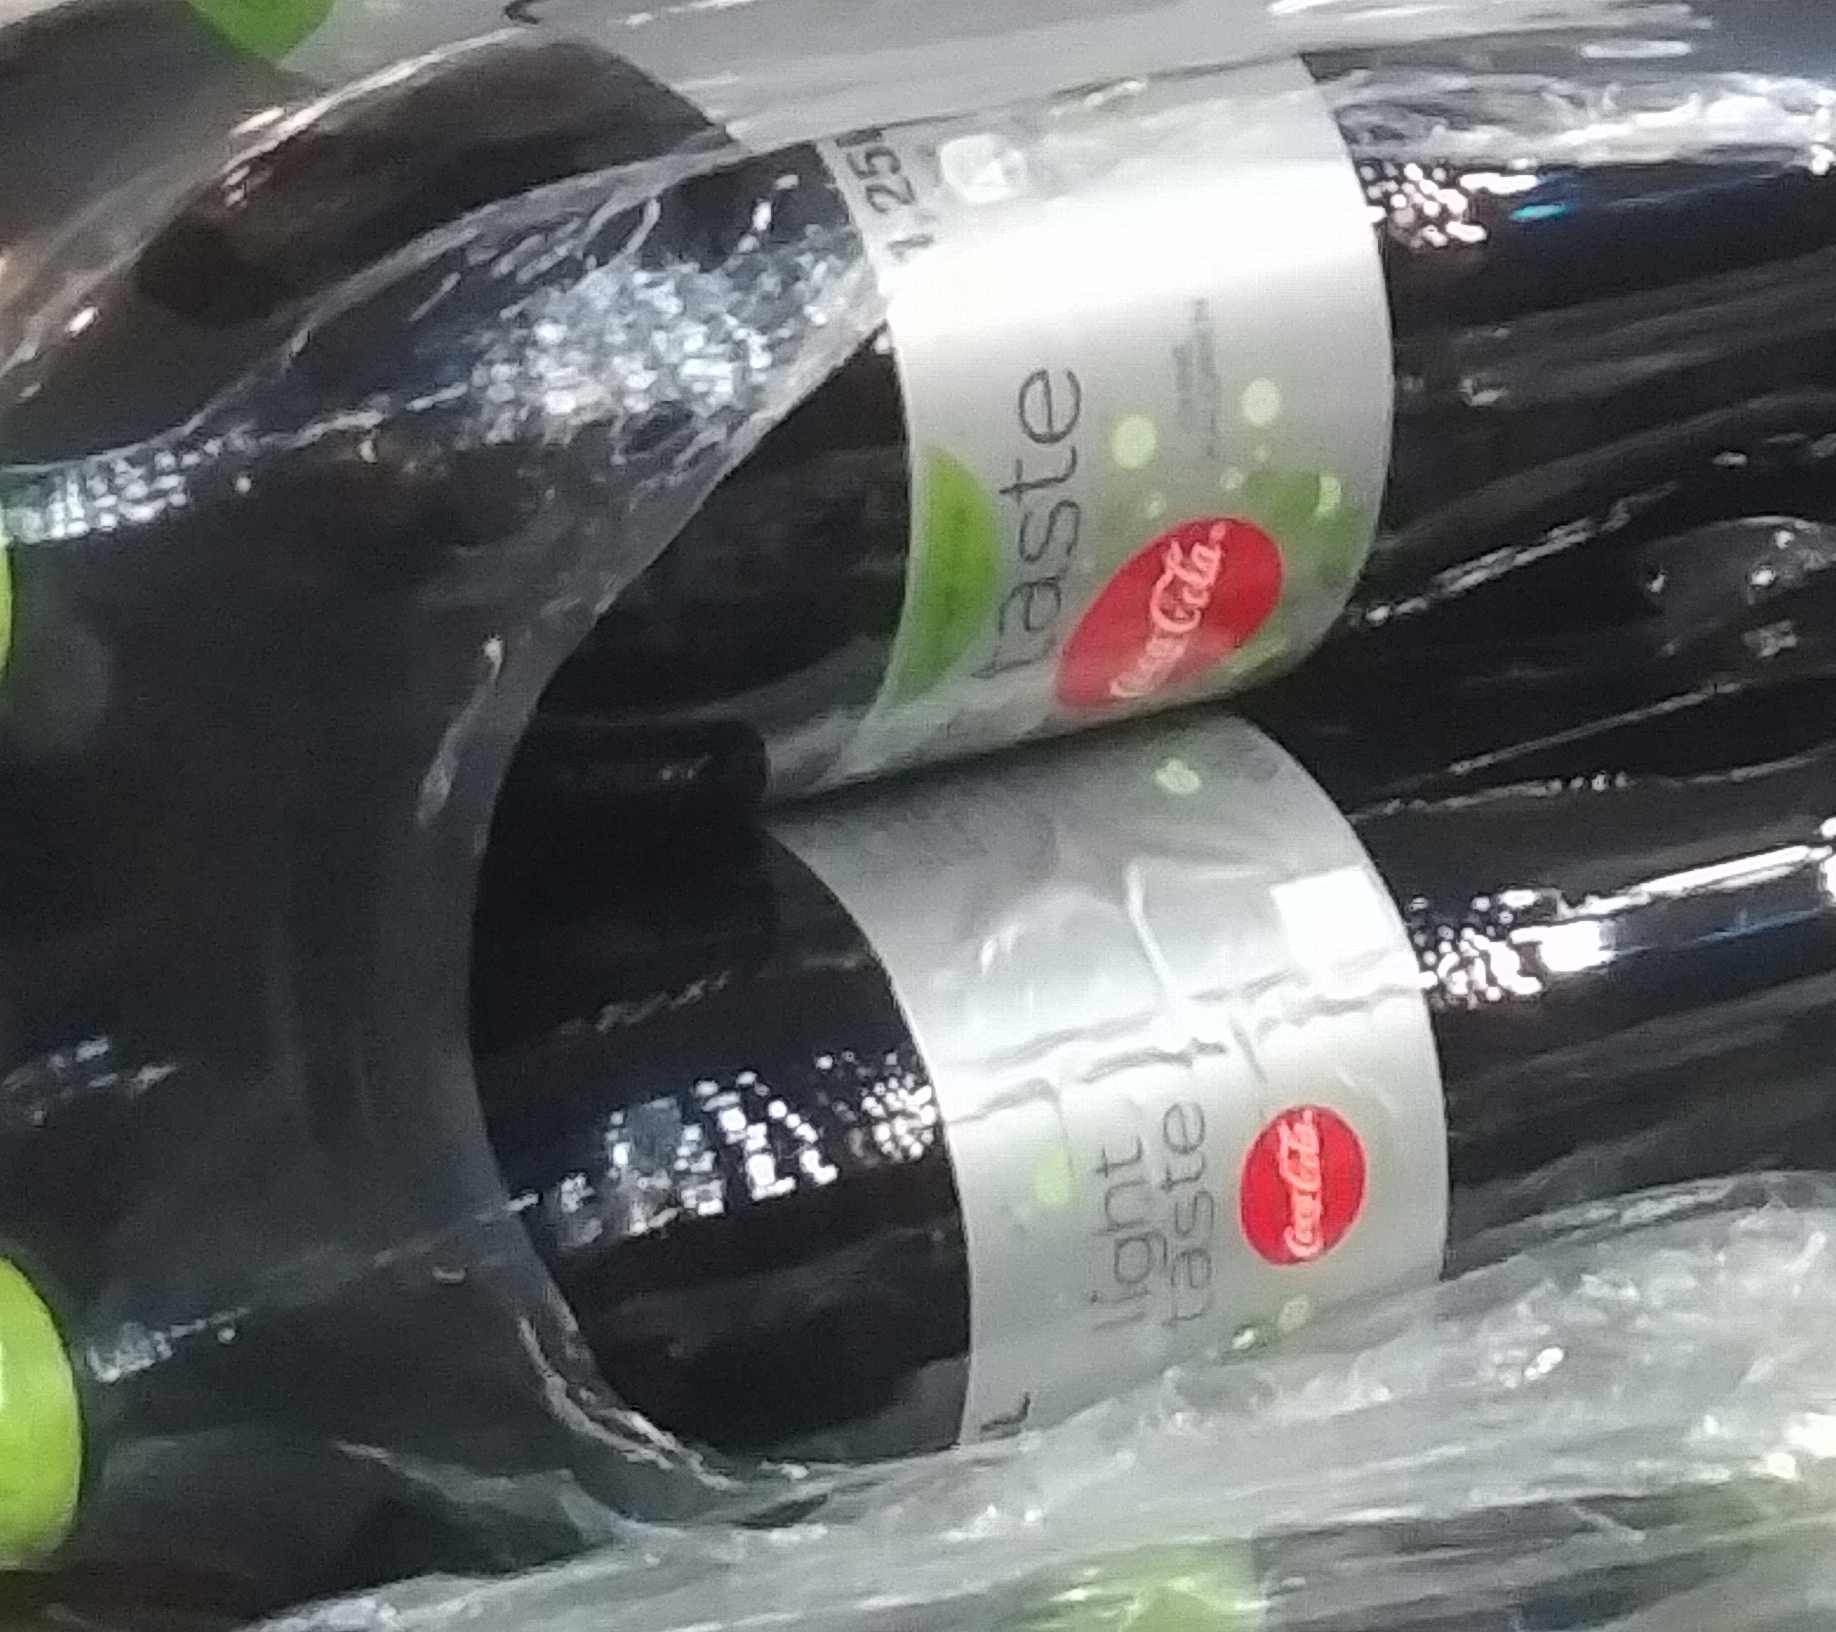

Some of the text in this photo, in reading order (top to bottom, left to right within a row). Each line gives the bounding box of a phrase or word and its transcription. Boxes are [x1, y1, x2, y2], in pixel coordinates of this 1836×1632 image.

[972, 364, 1083, 681] taste
[1091, 1136, 1168, 1333] light
[1160, 1101, 1215, 1328] taste
[1277, 1108, 1325, 1259] Coca-Cola
